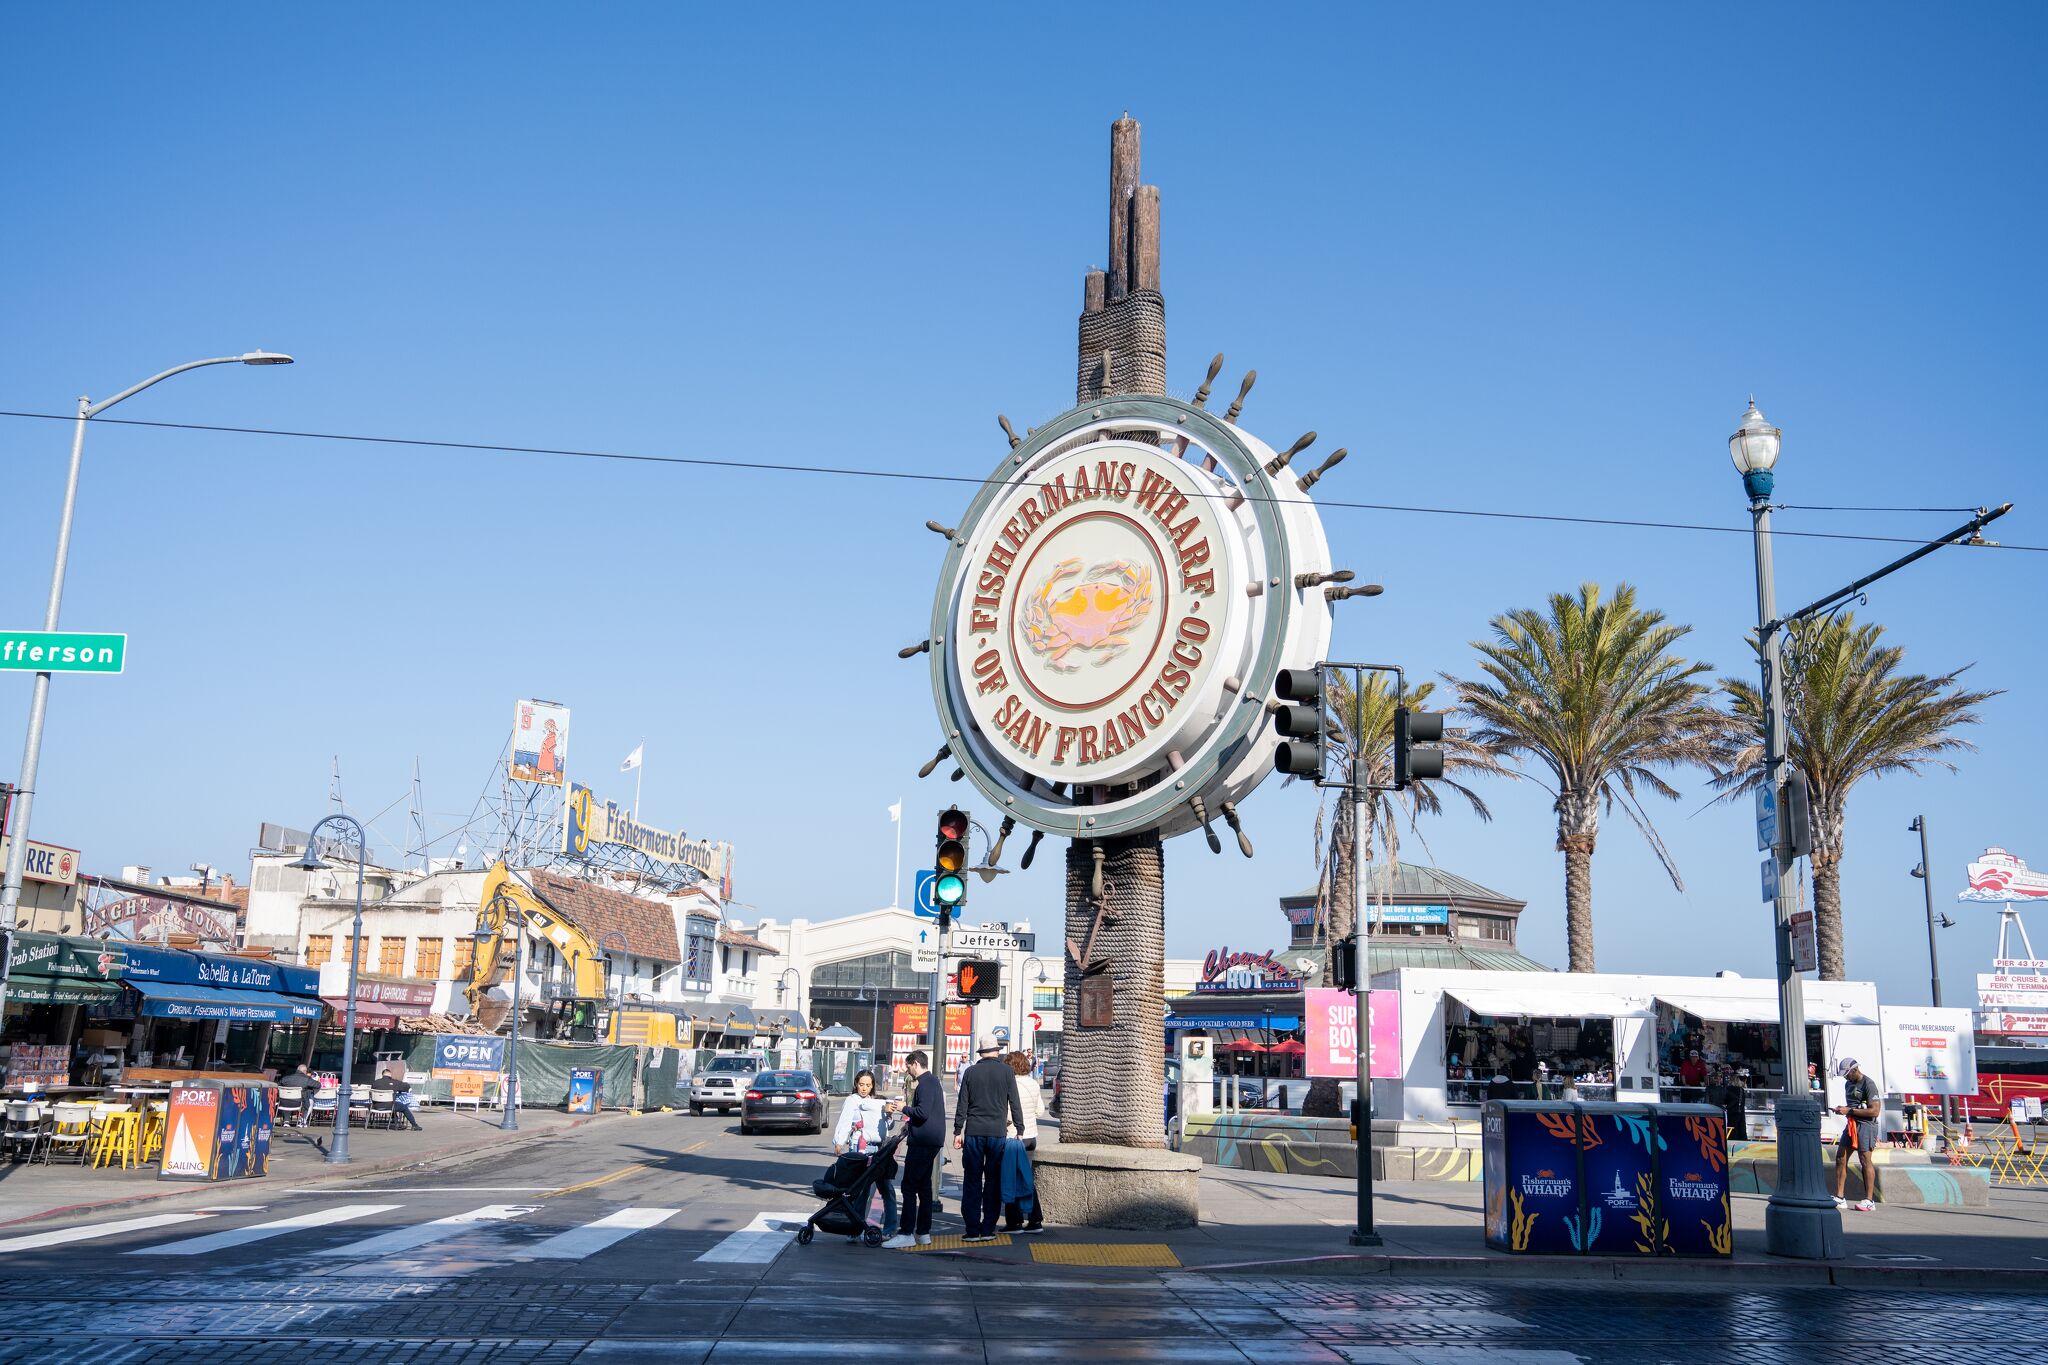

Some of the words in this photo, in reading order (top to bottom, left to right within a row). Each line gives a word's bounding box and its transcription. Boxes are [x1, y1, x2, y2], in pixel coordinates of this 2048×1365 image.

[970, 461, 1137, 633] FISHERMANS
[1136, 467, 1216, 598] WHARF
[3, 641, 114, 663] fferson
[971, 648, 1010, 697] OF
[993, 694, 1051, 756] SAN
[1052, 616, 1212, 766] FRANCISCO
[521, 714, 532, 731] 9
[575, 788, 593, 853] 9
[606, 800, 677, 858] Fishermen's
[677, 828, 712, 872] Grotto
[533, 913, 547, 928] CAT
[989, 922, 1007, 931] 200
[959, 934, 1028, 949] Jefferson
[29, 942, 59, 962] Station
[1202, 946, 1289, 982] Chowder
[198, 963, 230, 982] Sabella
[232, 973, 239, 982] &
[240, 967, 271, 986] LaTorre
[1994, 975, 2009, 983] BAY
[1990, 982, 2014, 990] FERRY
[827, 990, 854, 998] PIER
[167, 1004, 192, 1015] ORIGINAL
[192, 1005, 228, 1017] FISHERMAN'S
[229, 1007, 247, 1018] WHARF
[1328, 1005, 1375, 1026] SUPR
[677, 1020, 693, 1041] CAT
[1899, 1023, 1920, 1031] OFFICIAL
[1921, 1024, 1956, 1033] MERCHANDISE
[443, 1044, 493, 1062] OPEN
[180, 1090, 213, 1102] PORT
[1486, 1116, 1502, 1133] PORT
[167, 1160, 205, 1171] SAILING
[1521, 1174, 1572, 1186] Fisherman's
[1669, 1177, 1719, 1190] Fisherman's
[1522, 1184, 1572, 1198] WHARF
[1670, 1187, 1719, 1201] WHARF
